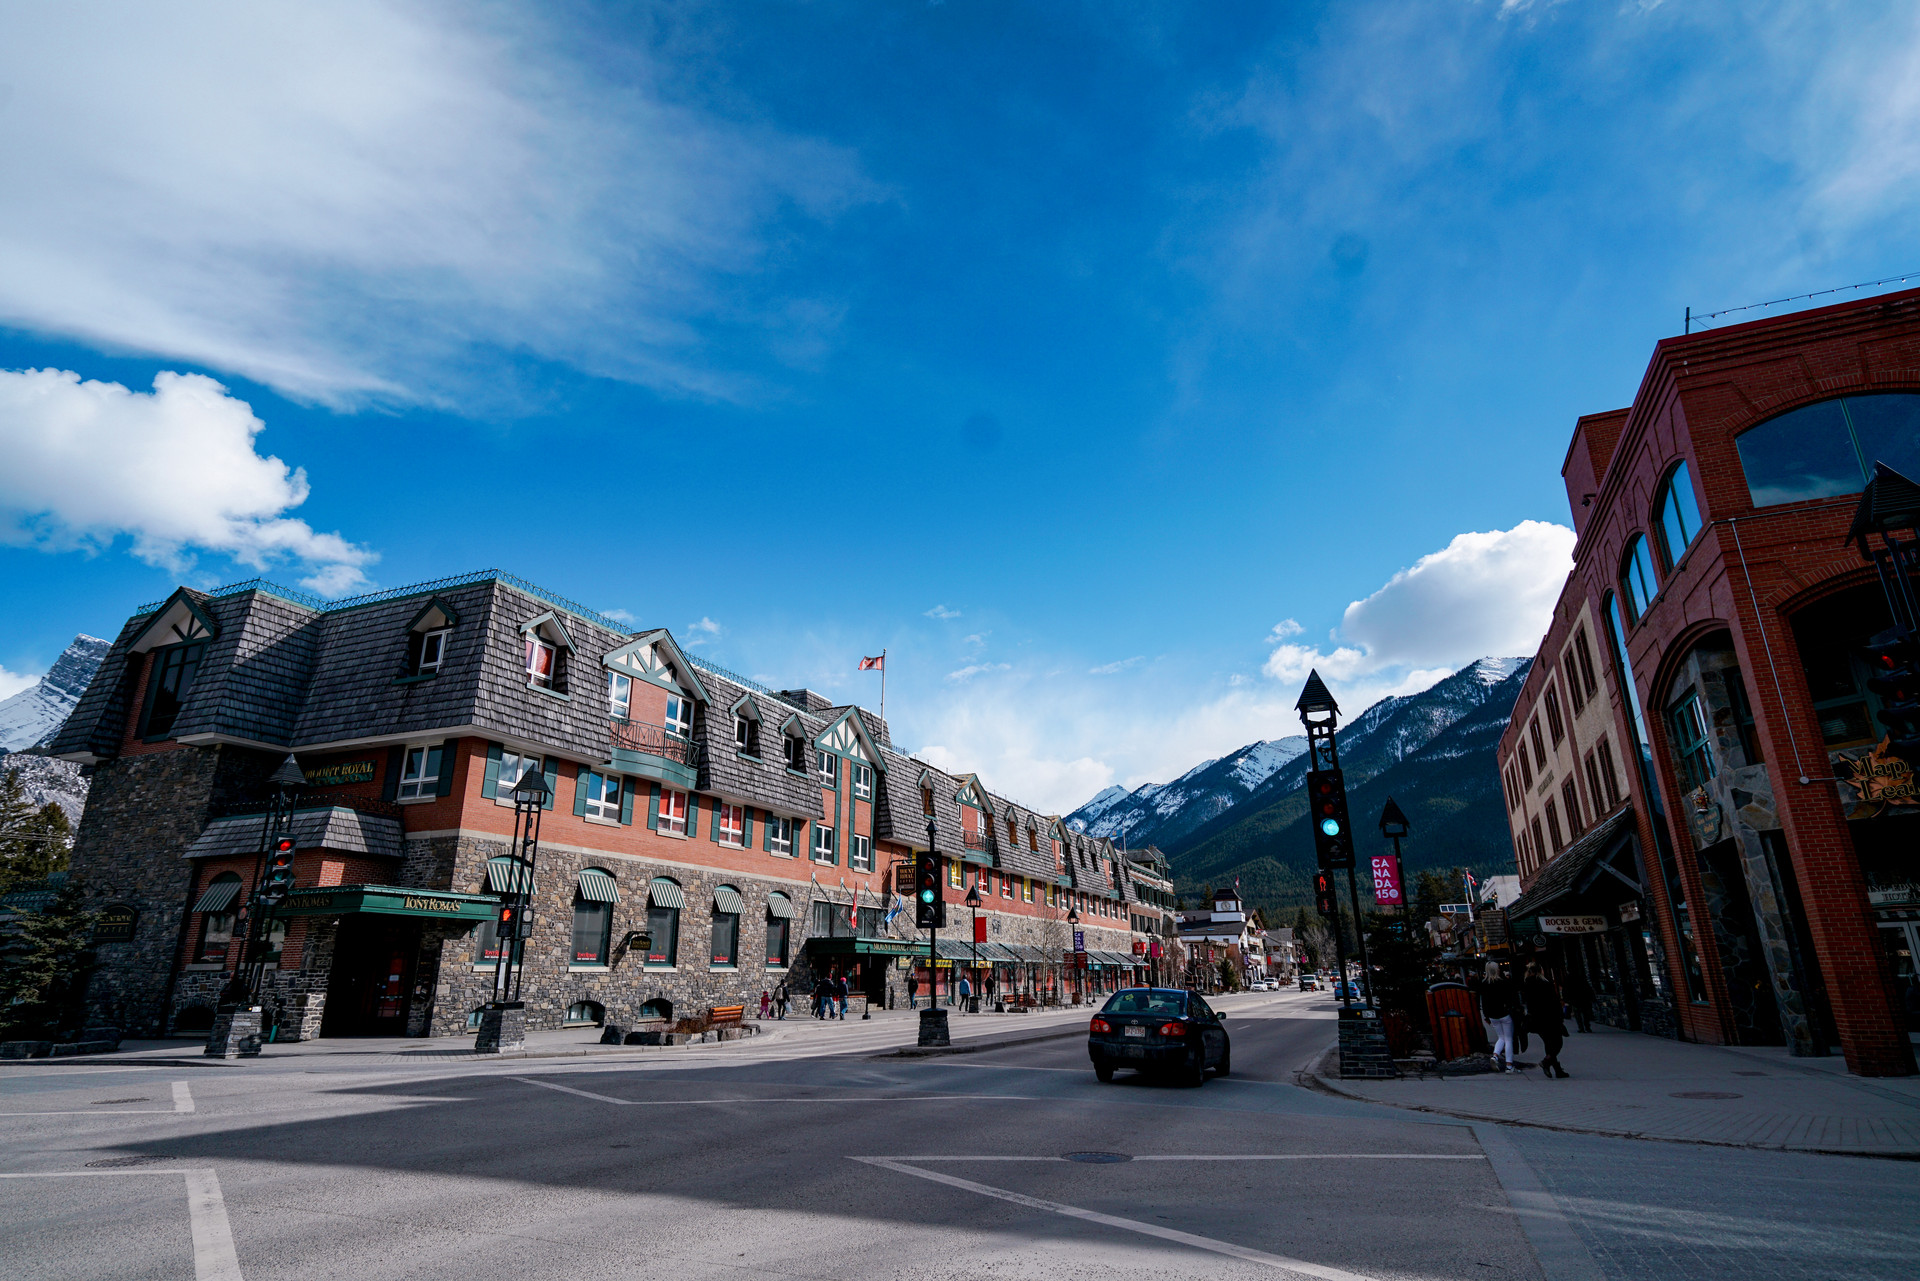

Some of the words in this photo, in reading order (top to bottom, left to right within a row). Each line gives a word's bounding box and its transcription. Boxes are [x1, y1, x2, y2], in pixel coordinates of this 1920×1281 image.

[341, 762, 374, 775] ROYAL
[1371, 858, 1390, 868] CA
[1373, 868, 1391, 878] NA
[1374, 879, 1393, 888] DA
[1545, 918, 1571, 926] ROCKS
